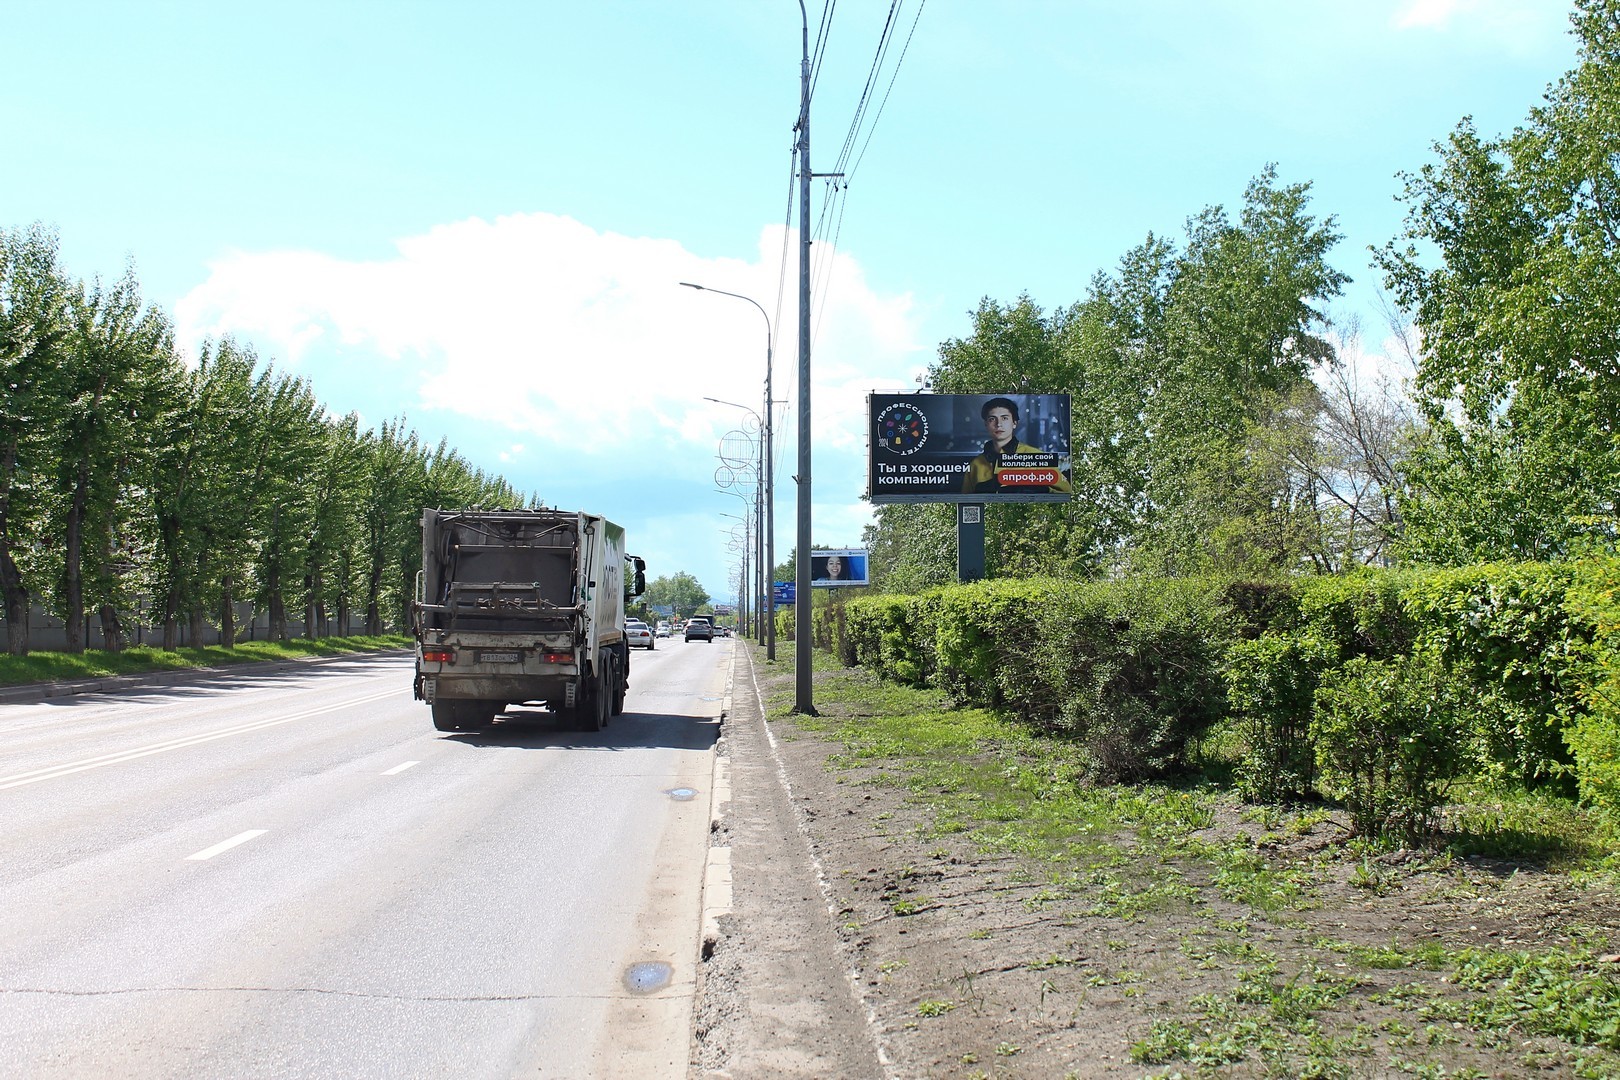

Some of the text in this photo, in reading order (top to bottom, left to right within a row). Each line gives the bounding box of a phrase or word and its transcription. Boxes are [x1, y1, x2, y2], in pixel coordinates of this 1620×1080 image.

[877, 402, 929, 456] ПРОФЕССИОНАЛИТЕТ
[1001, 452, 1054, 461] Выбери свой
[877, 462, 971, 475] Ты в хорошей
[878, 474, 950, 484] компании!
[1002, 472, 1054, 483] япроф.рф
